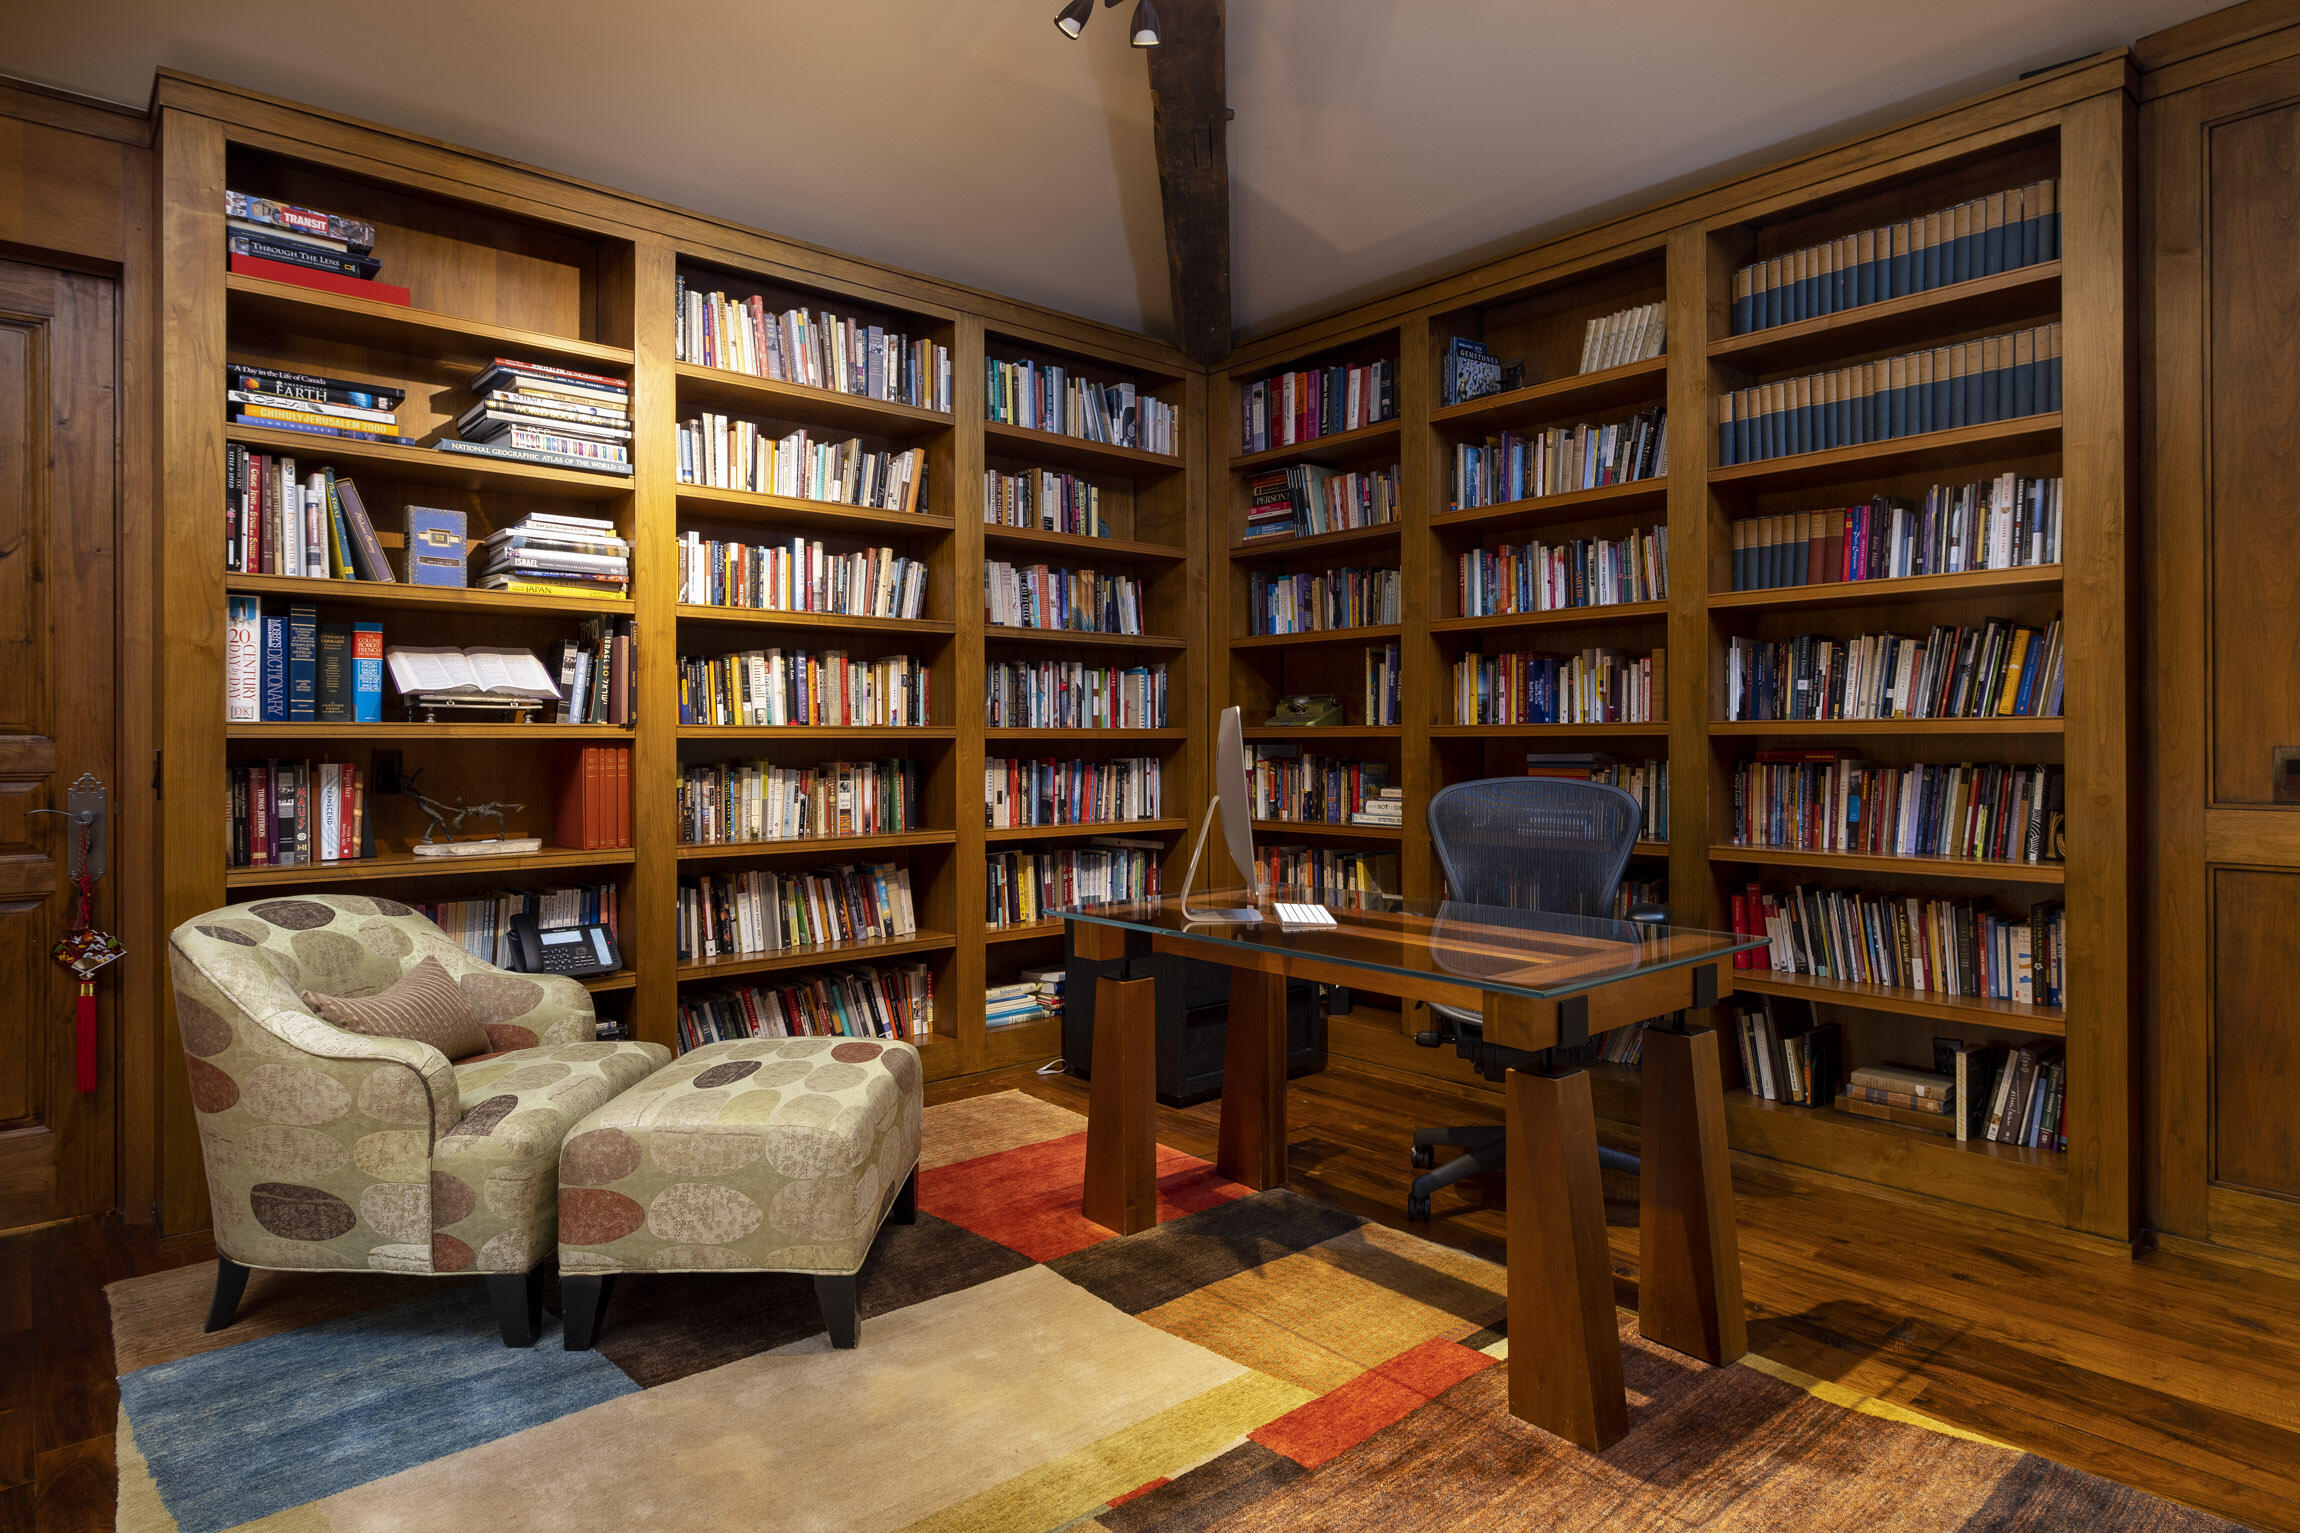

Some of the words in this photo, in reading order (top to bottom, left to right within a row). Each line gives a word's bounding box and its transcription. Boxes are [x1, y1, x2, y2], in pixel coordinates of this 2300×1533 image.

[284, 212, 328, 231] TRANSIT
[251, 241, 298, 258] THROUGH
[299, 251, 318, 262] THE
[320, 256, 340, 266] LENS
[1460, 350, 1499, 364] GEMSTONES
[243, 367, 257, 377] Day
[266, 370, 278, 378] the
[279, 371, 292, 380] Life
[293, 373, 301, 381] of
[301, 375, 326, 385] Canada
[276, 385, 327, 402] EARTH
[260, 408, 303, 422] CHIHULY
[303, 413, 360, 431] JERUSALEM
[362, 424, 386, 434] 2000
[452, 443, 491, 453] NATIONAL
[492, 448, 539, 460] GEOGRAPHIC
[542, 454, 563, 463] ATLAS
[564, 456, 573, 464] OF
[576, 458, 590, 467] THE
[591, 460, 616, 470] WORLD
[250, 468, 259, 488] GREAT
[328, 482, 336, 494] The
[250, 489, 258, 505] JEWS
[331, 496, 340, 518] Stars
[250, 512, 258, 529] STAGE
[250, 537, 258, 559] SCREEN
[287, 511, 295, 564] ENCYCLOPEDIA
[515, 559, 538, 567] ISRAEL
[526, 586, 552, 594] JAPAN
[229, 628, 251, 644] 20
[271, 619, 282, 648] MOSBY'S
[229, 644, 241, 667] DAY
[603, 636, 611, 663] ISRAEL
[242, 644, 257, 700] CENTURY
[602, 665, 609, 676] 20
[754, 659, 765, 698] Churchill
[798, 657, 806, 679] LIT
[229, 678, 241, 699] DAY
[267, 647, 284, 719] DICTIONARY
[234, 706, 251, 717] DK
[343, 768, 353, 798] Together
[257, 788, 265, 810] THOMAS
[297, 787, 307, 830] MAUS
[257, 810, 265, 838] JEFFERSON
[1902, 943, 1910, 963] Myself
[2047, 1092, 2055, 1113] dictionary
